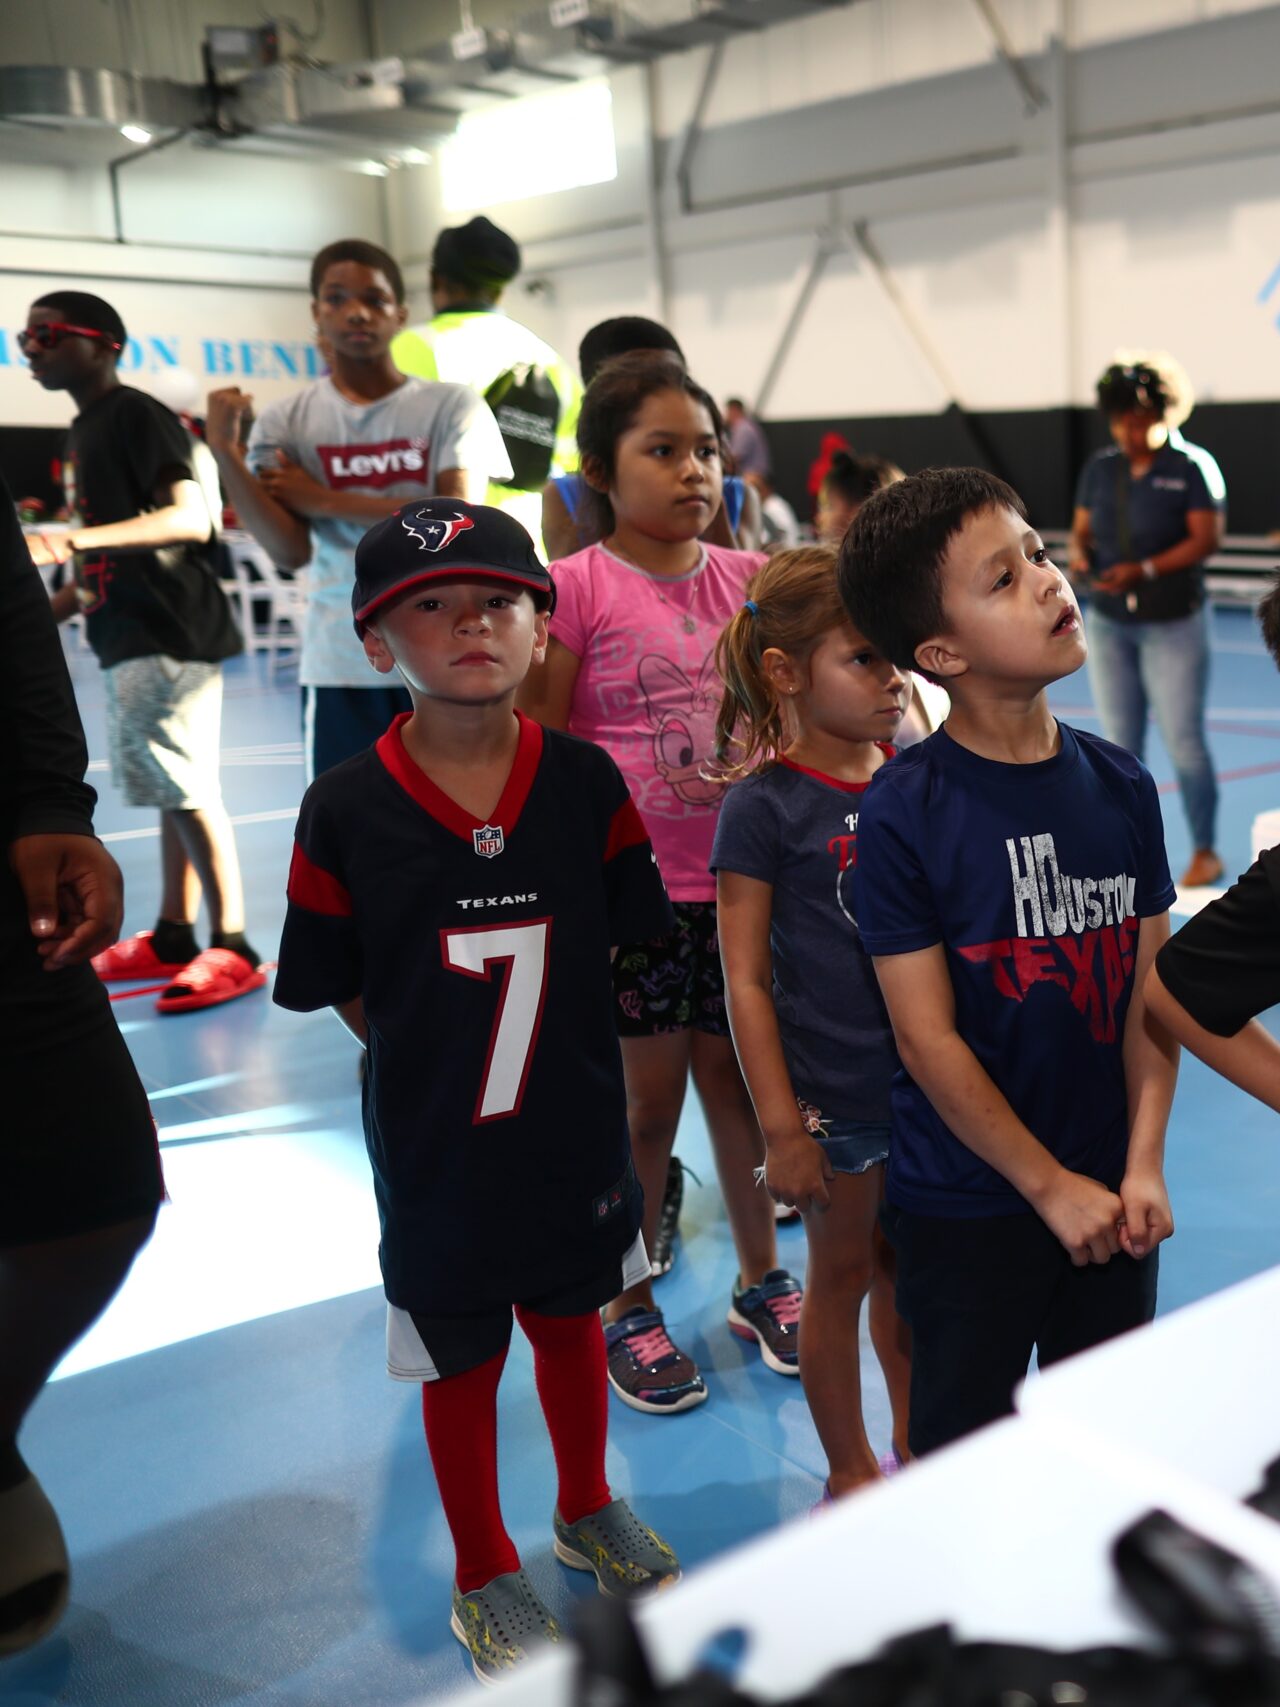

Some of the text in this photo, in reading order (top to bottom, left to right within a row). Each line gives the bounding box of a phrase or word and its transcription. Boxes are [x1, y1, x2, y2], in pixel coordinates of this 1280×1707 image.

[479, 839, 501, 854] NFL
[456, 892, 538, 910] TEXANS
[957, 917, 1140, 1045] TEXAS
[439, 916, 552, 1125] 7
